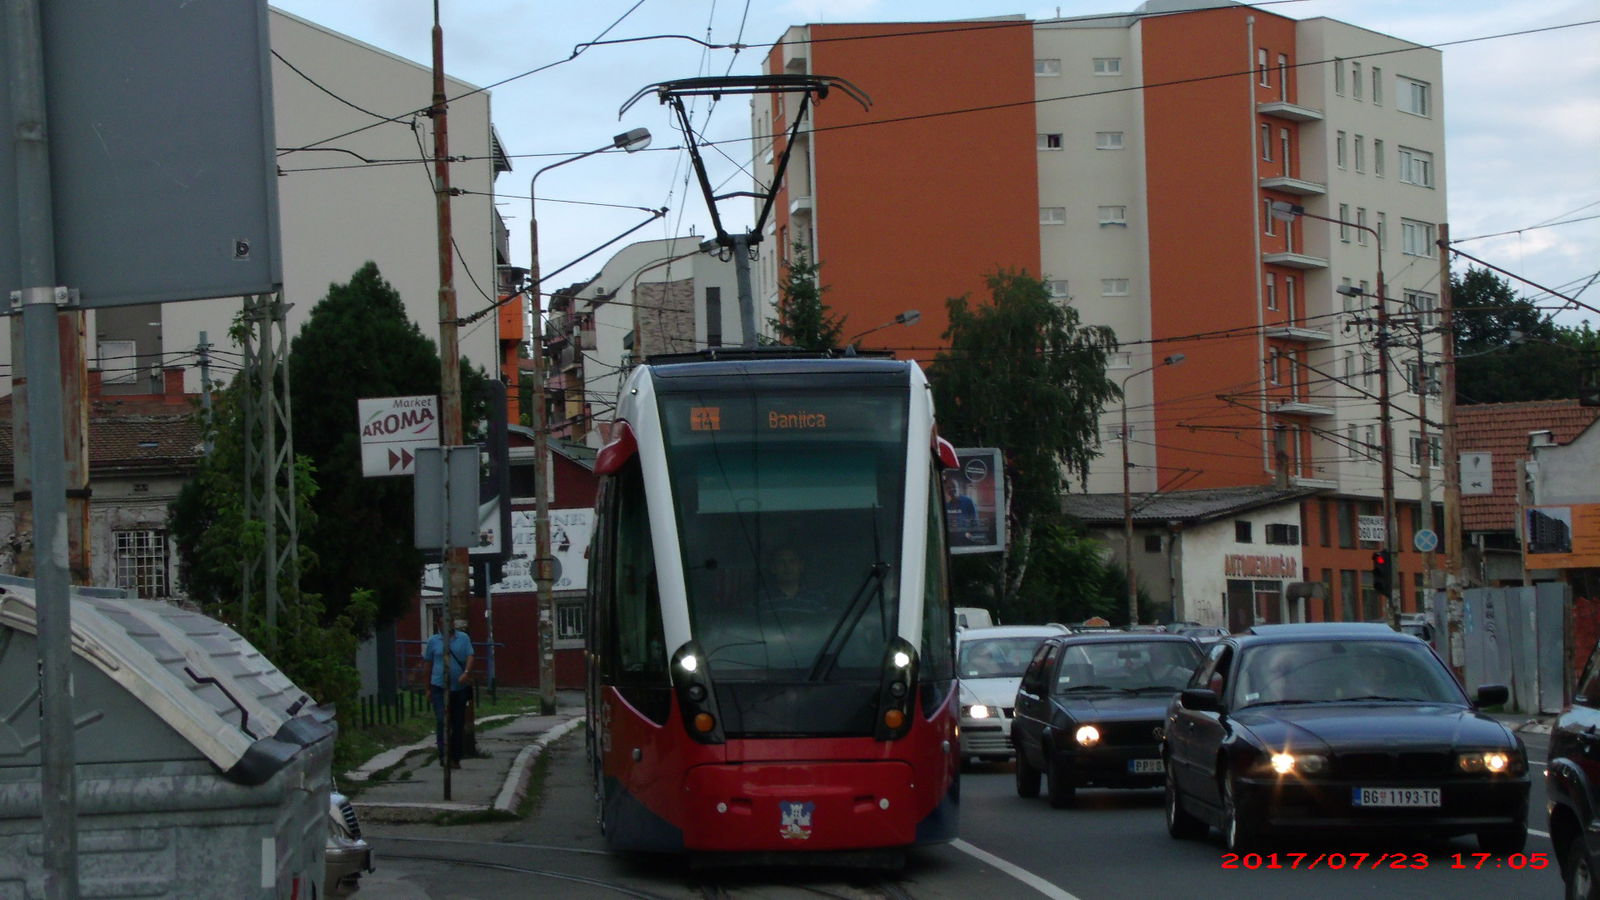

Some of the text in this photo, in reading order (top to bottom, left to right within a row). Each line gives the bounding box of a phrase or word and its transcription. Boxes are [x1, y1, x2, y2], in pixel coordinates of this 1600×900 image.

[393, 397, 432, 408] Market
[362, 408, 435, 436] AROMA
[768, 410, 826, 429] Banjica
[1363, 790, 1379, 804] BG
